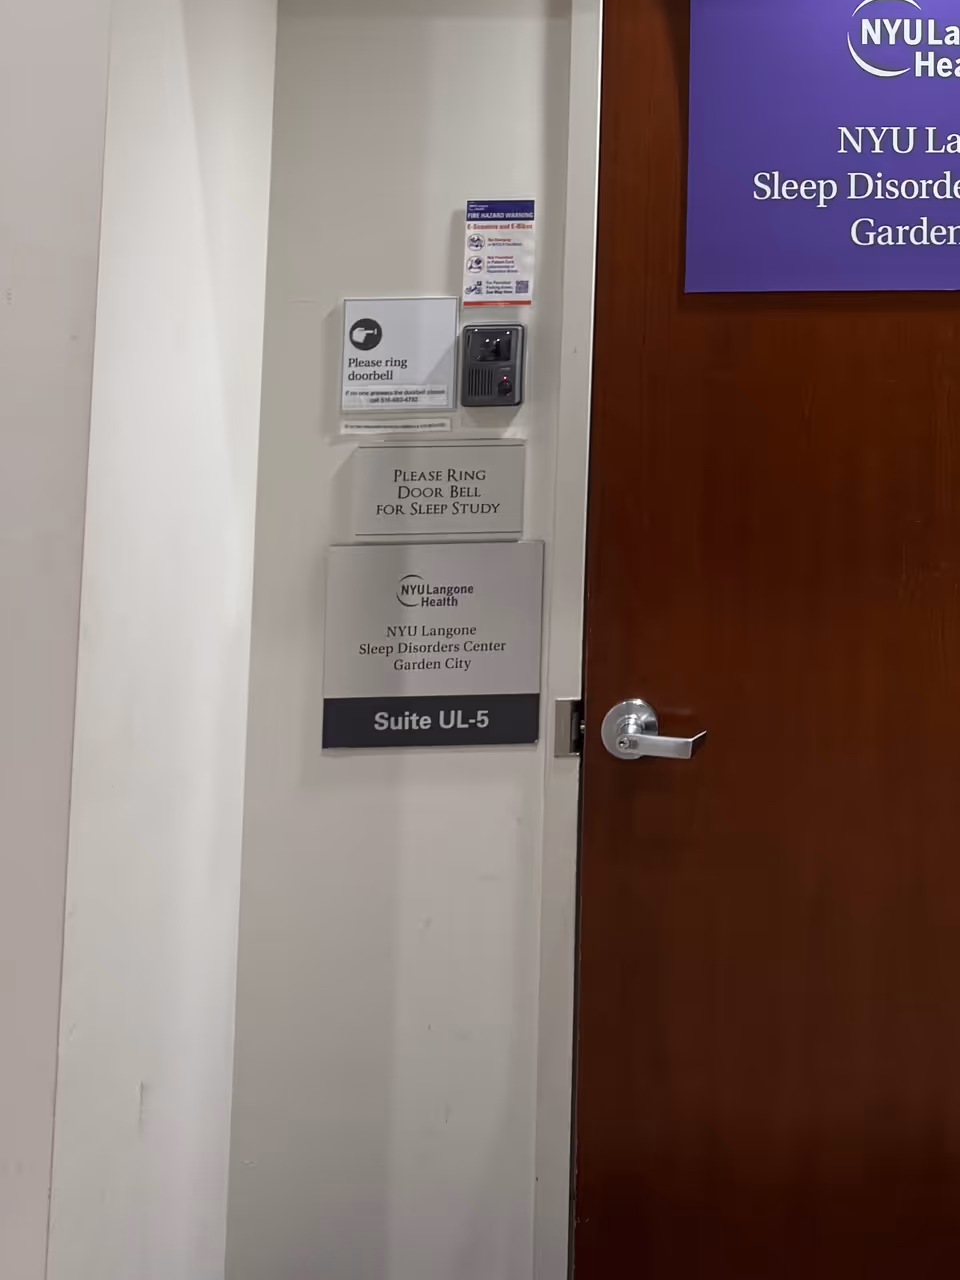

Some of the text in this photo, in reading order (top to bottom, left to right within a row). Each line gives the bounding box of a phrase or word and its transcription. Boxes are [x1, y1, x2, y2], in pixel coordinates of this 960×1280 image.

[861, 19, 922, 45] NYU
[837, 126, 917, 154] NYU
[752, 172, 838, 207] Sleep
[348, 358, 408, 369] Please ring
[348, 370, 394, 381] doorbell
[393, 469, 486, 482] PLEASE RING
[397, 486, 481, 499] DOOR BELL
[376, 502, 500, 516] FOR SLEEP STUDY
[401, 584, 474, 596] NYU Langone
[421, 596, 458, 608] Health
[386, 625, 477, 638] NYU Langone
[359, 640, 507, 657] Sleep Disorders Center
[393, 658, 471, 671] Garden City
[374, 710, 489, 731] Suite UL-5
